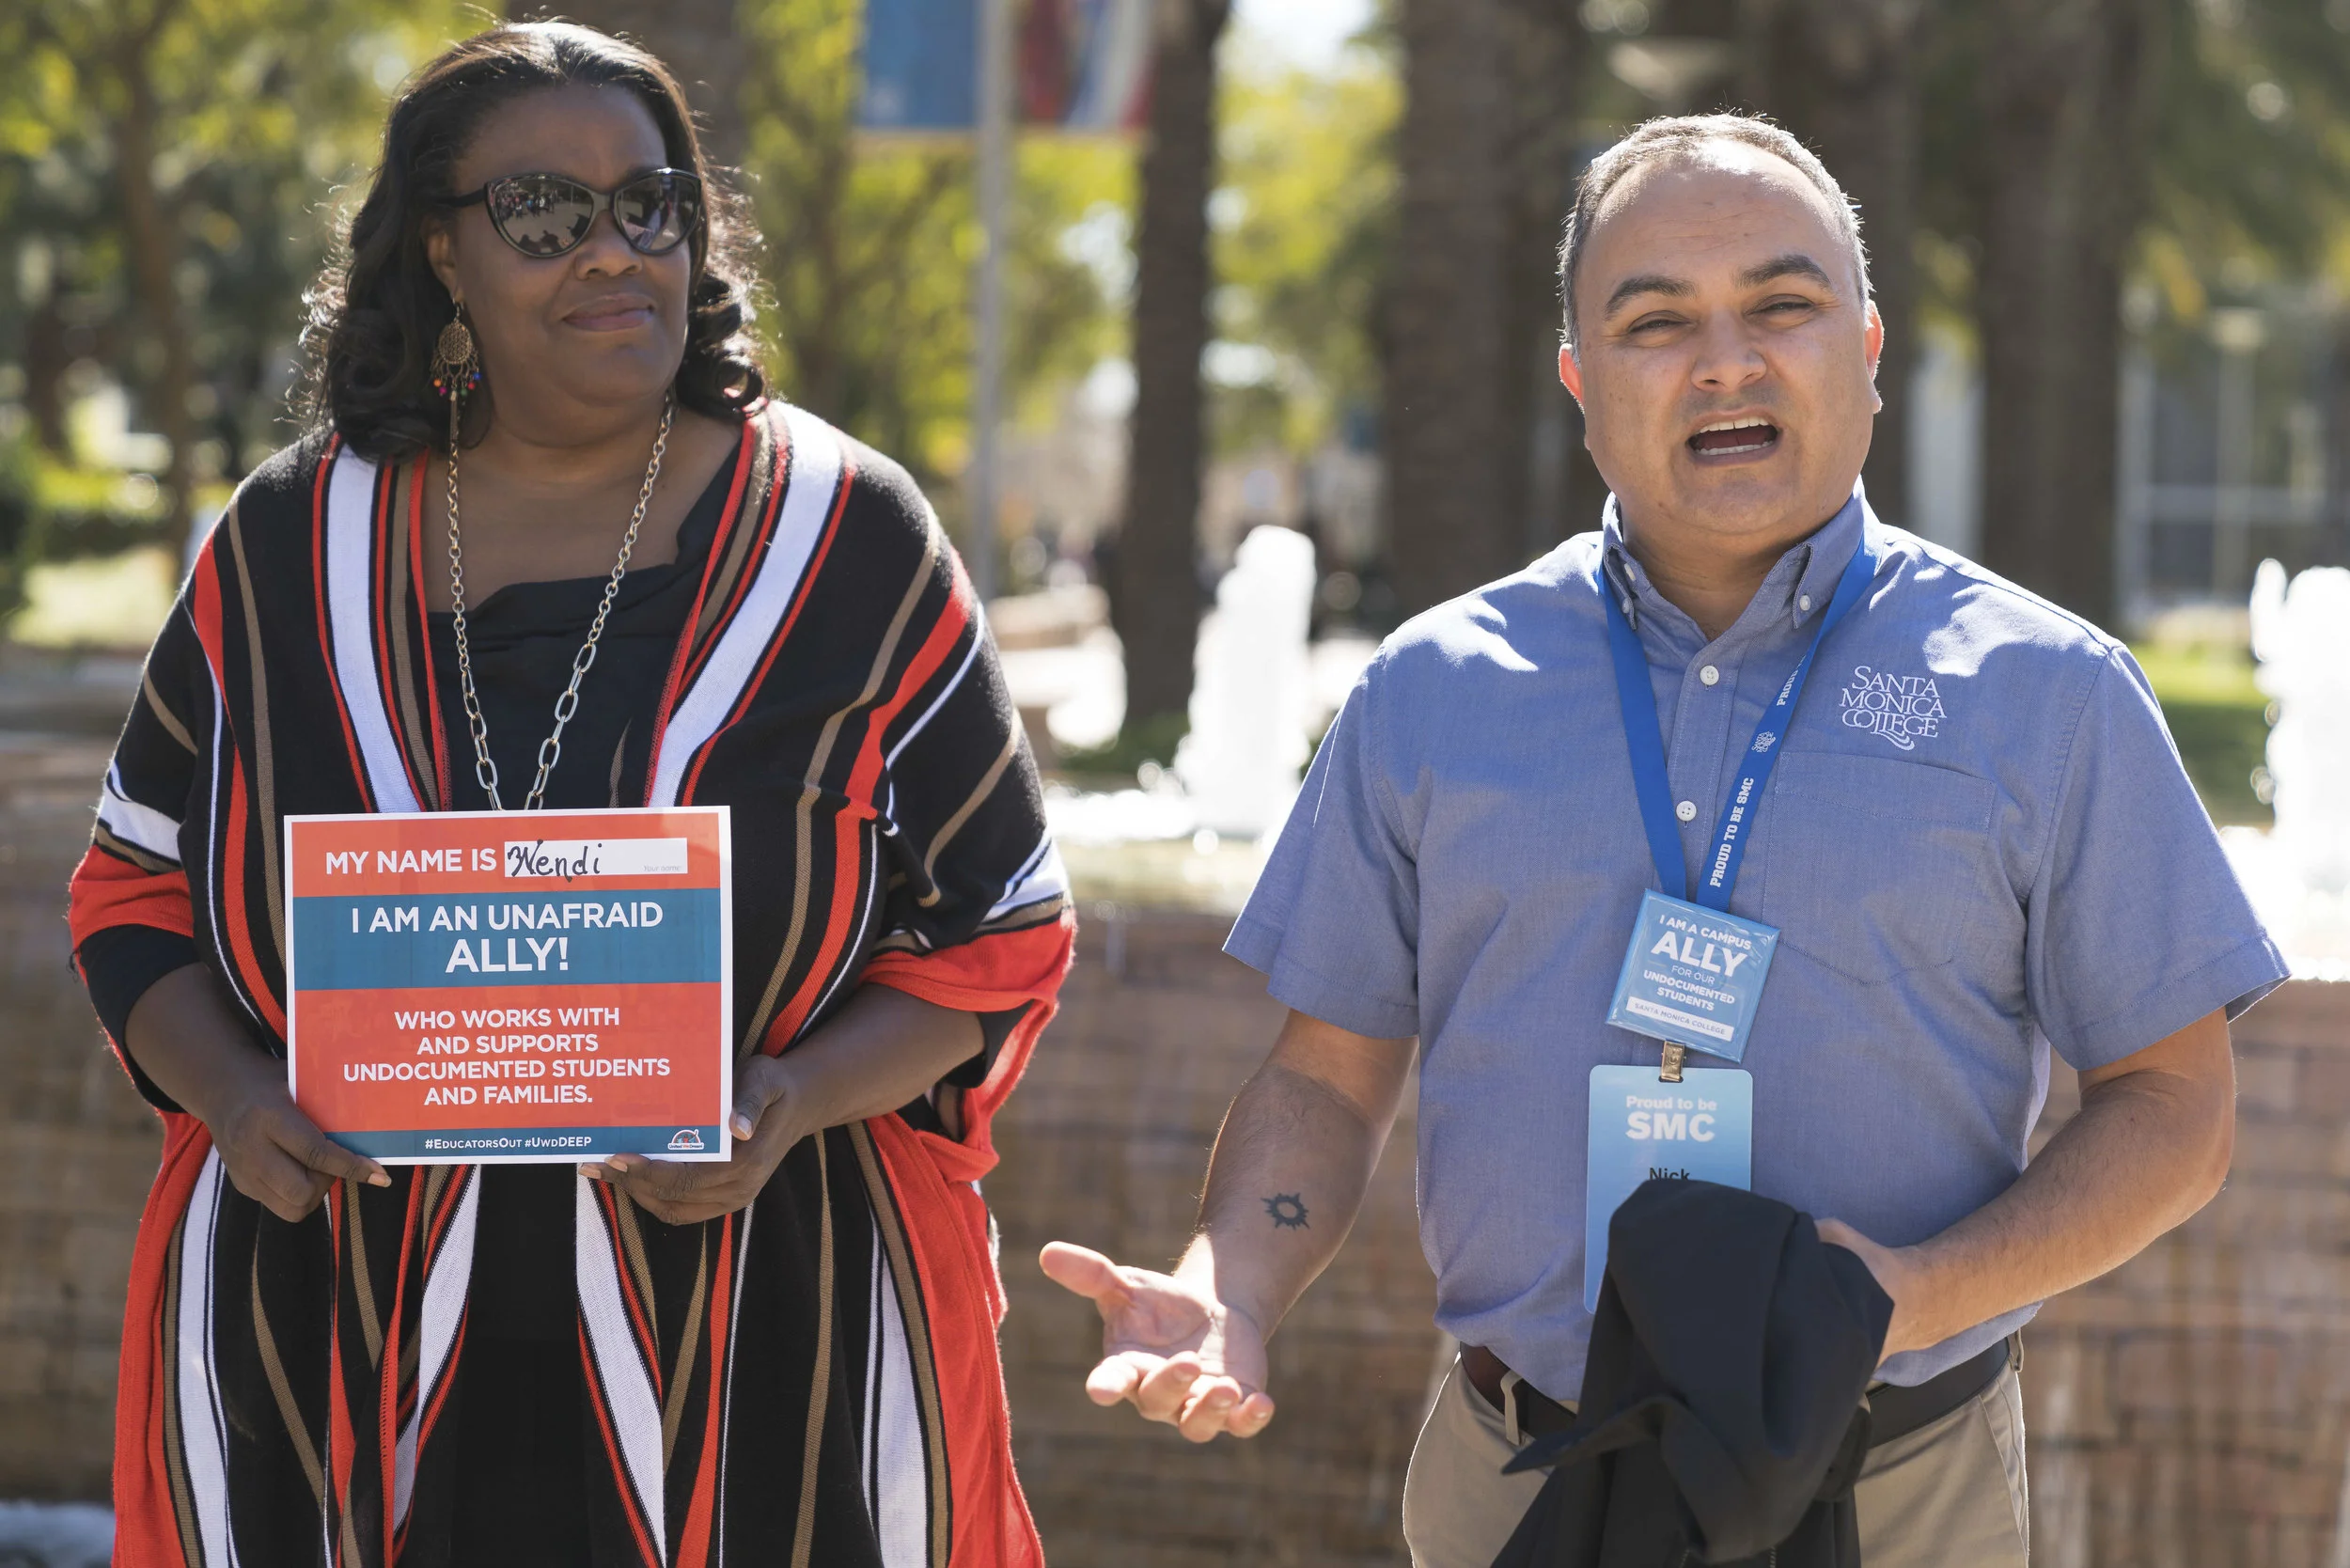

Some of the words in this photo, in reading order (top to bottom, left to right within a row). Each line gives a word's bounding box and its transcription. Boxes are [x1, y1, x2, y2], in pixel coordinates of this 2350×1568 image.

[1852, 666, 1940, 698] SANTA
[1839, 688, 1947, 718] MONICA
[1842, 709, 1938, 750] COLLEGE
[1736, 777, 1754, 804] SMC
[1730, 806, 1744, 823] BE
[1723, 824, 1738, 840] TO
[326, 851, 369, 874] MY
[377, 849, 462, 873] NAME
[472, 848, 497, 871] IS
[508, 839, 603, 883] Wendi
[1710, 843, 1731, 887] PROUD
[352, 908, 359, 933] I
[368, 906, 419, 933] AM
[429, 905, 478, 932] AN
[488, 902, 664, 931] UNAFRAID
[1659, 915, 1666, 924] I
[1666, 917, 1686, 931] AM
[1687, 924, 1698, 934] A
[1700, 927, 1752, 950] CAMPUS
[445, 936, 569, 973] ALLY!
[1651, 931, 1747, 977] ALLY
[1643, 970, 1735, 1004] UNDOCUMENTED
[1671, 964, 1692, 979] FOR
[1694, 972, 1716, 985] OUR
[1657, 987, 1715, 1011] STUDENTS
[394, 1011, 456, 1030] WHO
[462, 1009, 552, 1028] WORKS
[558, 1007, 619, 1027] WITH
[1635, 1003, 1659, 1014] SANTA
[1661, 1011, 1690, 1026] MONICA
[1691, 1020, 1726, 1035] COLLEGE
[416, 1036, 470, 1055] AND
[476, 1033, 599, 1054] SUPPORTS
[343, 1060, 545, 1082] UNDOCUMENTED
[552, 1058, 670, 1078] STUDENTS
[424, 1087, 478, 1105] AND
[484, 1085, 593, 1105] FAMILIES.
[1626, 1095, 1673, 1109] Proud
[1677, 1098, 1694, 1110] to
[1698, 1097, 1717, 1111] be
[1625, 1111, 1716, 1142] SMC
